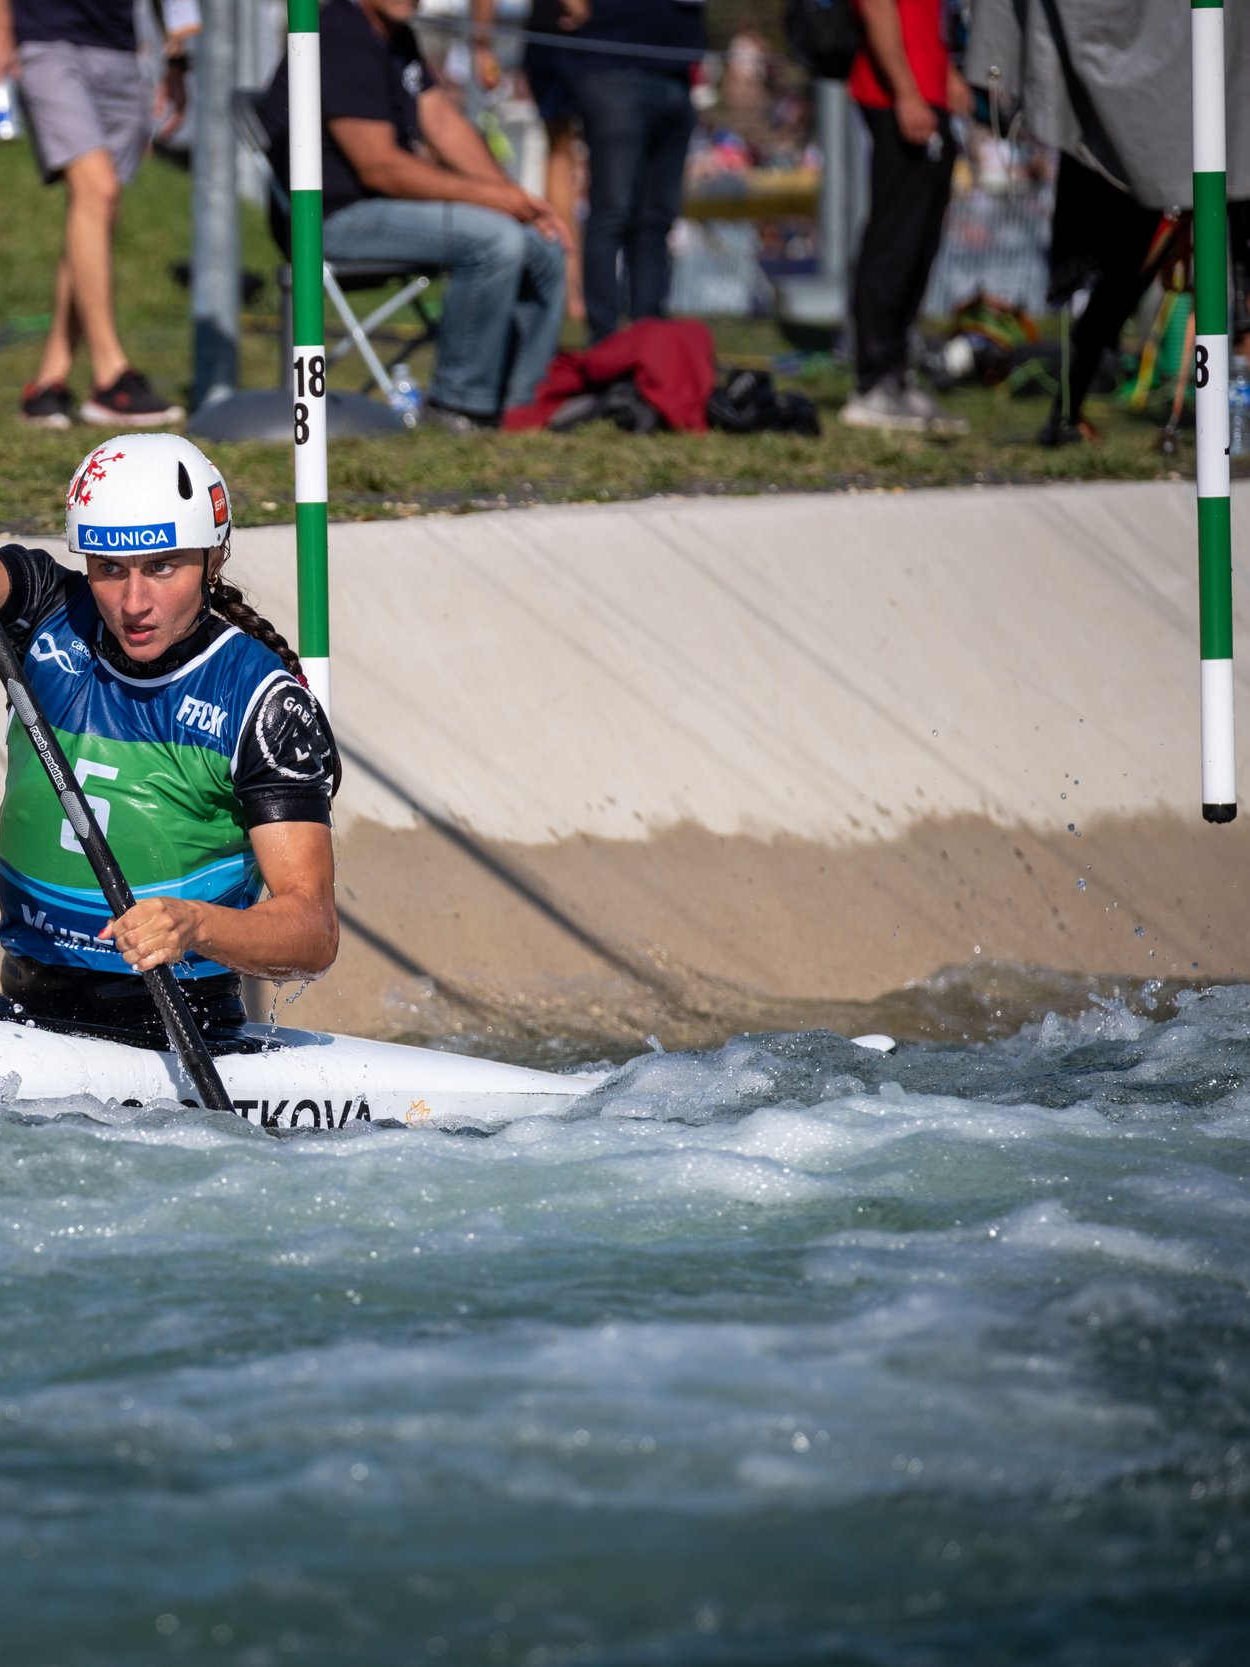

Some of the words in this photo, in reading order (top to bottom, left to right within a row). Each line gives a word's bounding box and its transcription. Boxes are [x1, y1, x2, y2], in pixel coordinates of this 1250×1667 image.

[293, 355, 326, 398] 18
[294, 402, 310, 446] 8
[106, 528, 169, 547] UNIQA
[175, 694, 229, 738] FFCK
[283, 696, 313, 727] GABI
[30, 725, 48, 751] raab
[40, 750, 67, 791] paddles
[60, 757, 119, 855] 5
